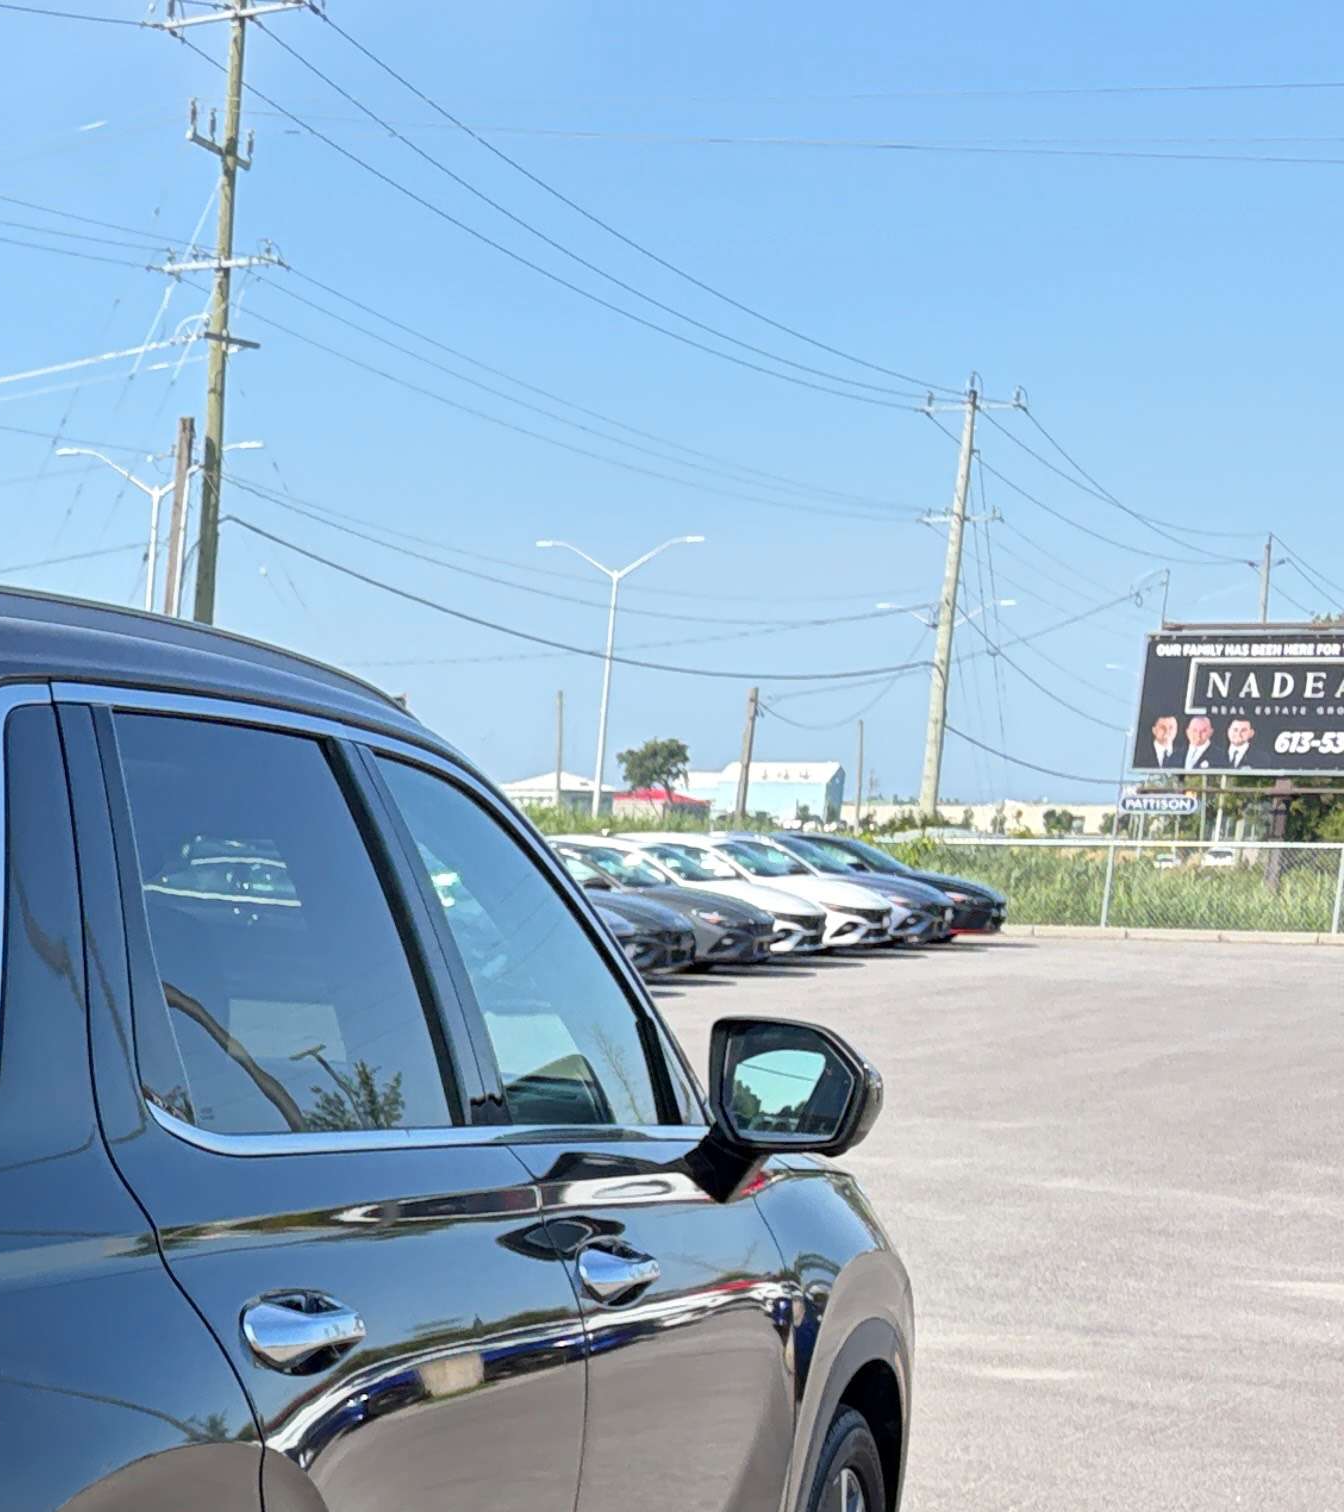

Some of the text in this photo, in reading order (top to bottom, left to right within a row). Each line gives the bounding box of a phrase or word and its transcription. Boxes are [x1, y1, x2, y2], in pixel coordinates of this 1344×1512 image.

[1156, 644, 1182, 657] OUR
[1183, 644, 1224, 657] FAMILY
[1225, 644, 1250, 657] HAS
[1251, 644, 1282, 657] BEEN
[1283, 644, 1314, 656] HERE
[1316, 644, 1341, 656] FOR
[1211, 706, 1245, 715] REAL
[1255, 706, 1307, 716] ESTATE
[1125, 799, 1191, 810] PATTISON
